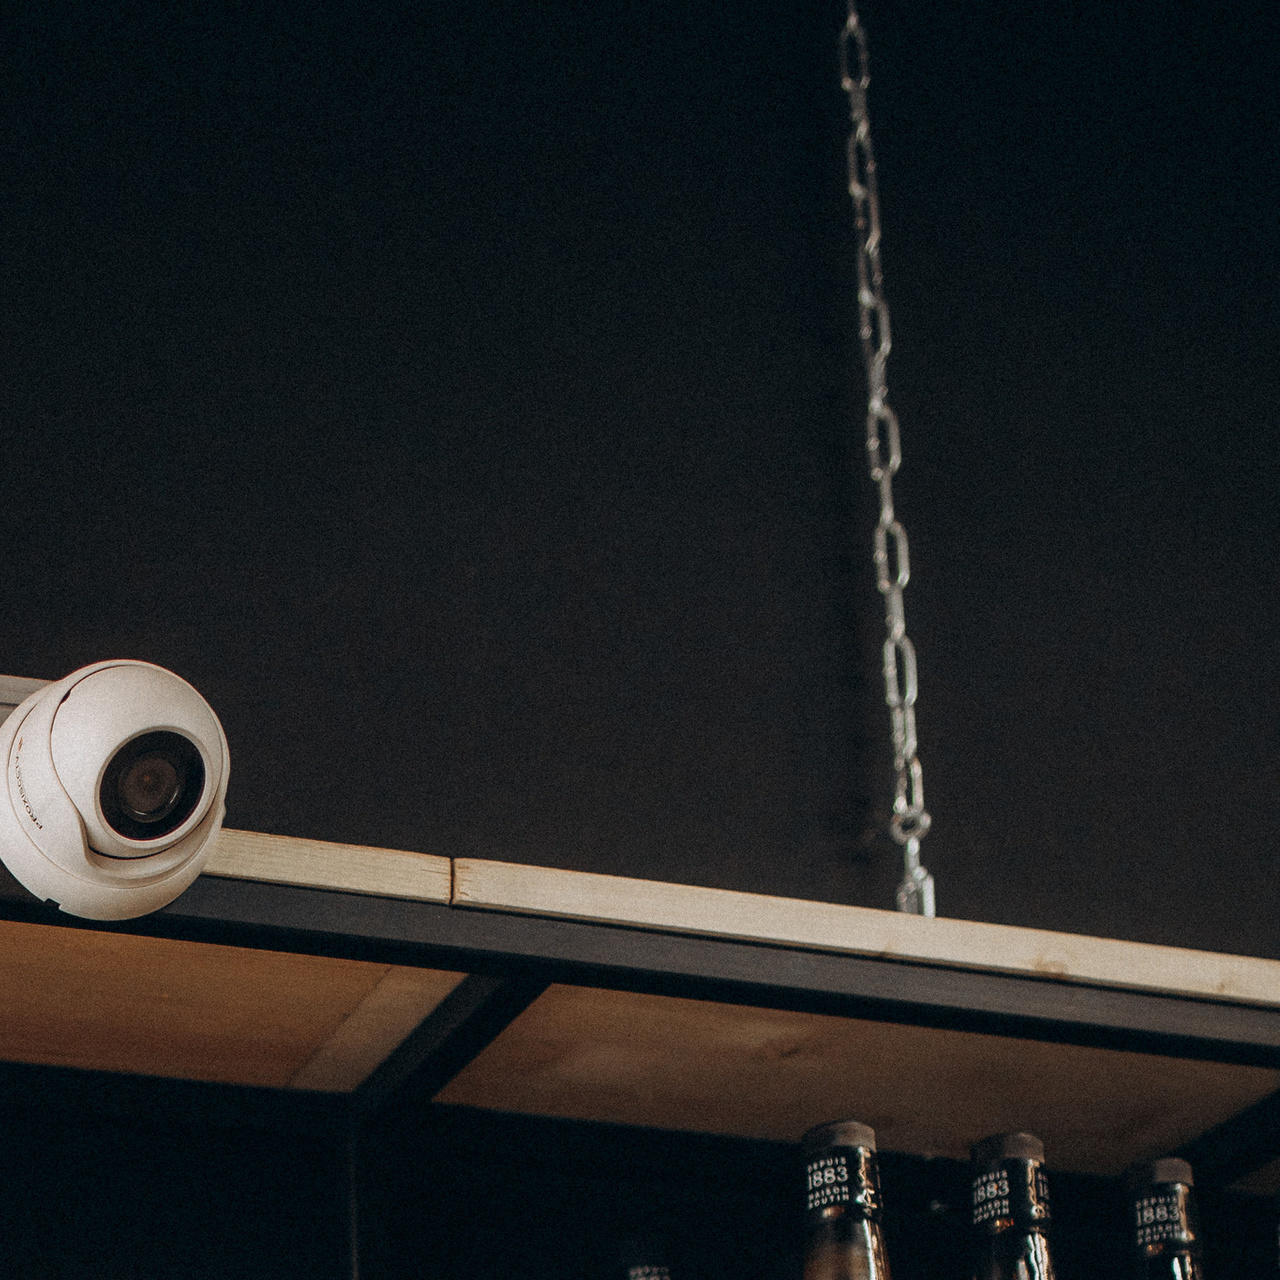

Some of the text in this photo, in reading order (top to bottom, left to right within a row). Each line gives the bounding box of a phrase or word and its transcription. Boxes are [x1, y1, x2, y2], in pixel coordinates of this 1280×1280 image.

[808, 1165, 849, 1191] 1883
[974, 1179, 1010, 1205] 1883
[1136, 1203, 1180, 1227] 1883
